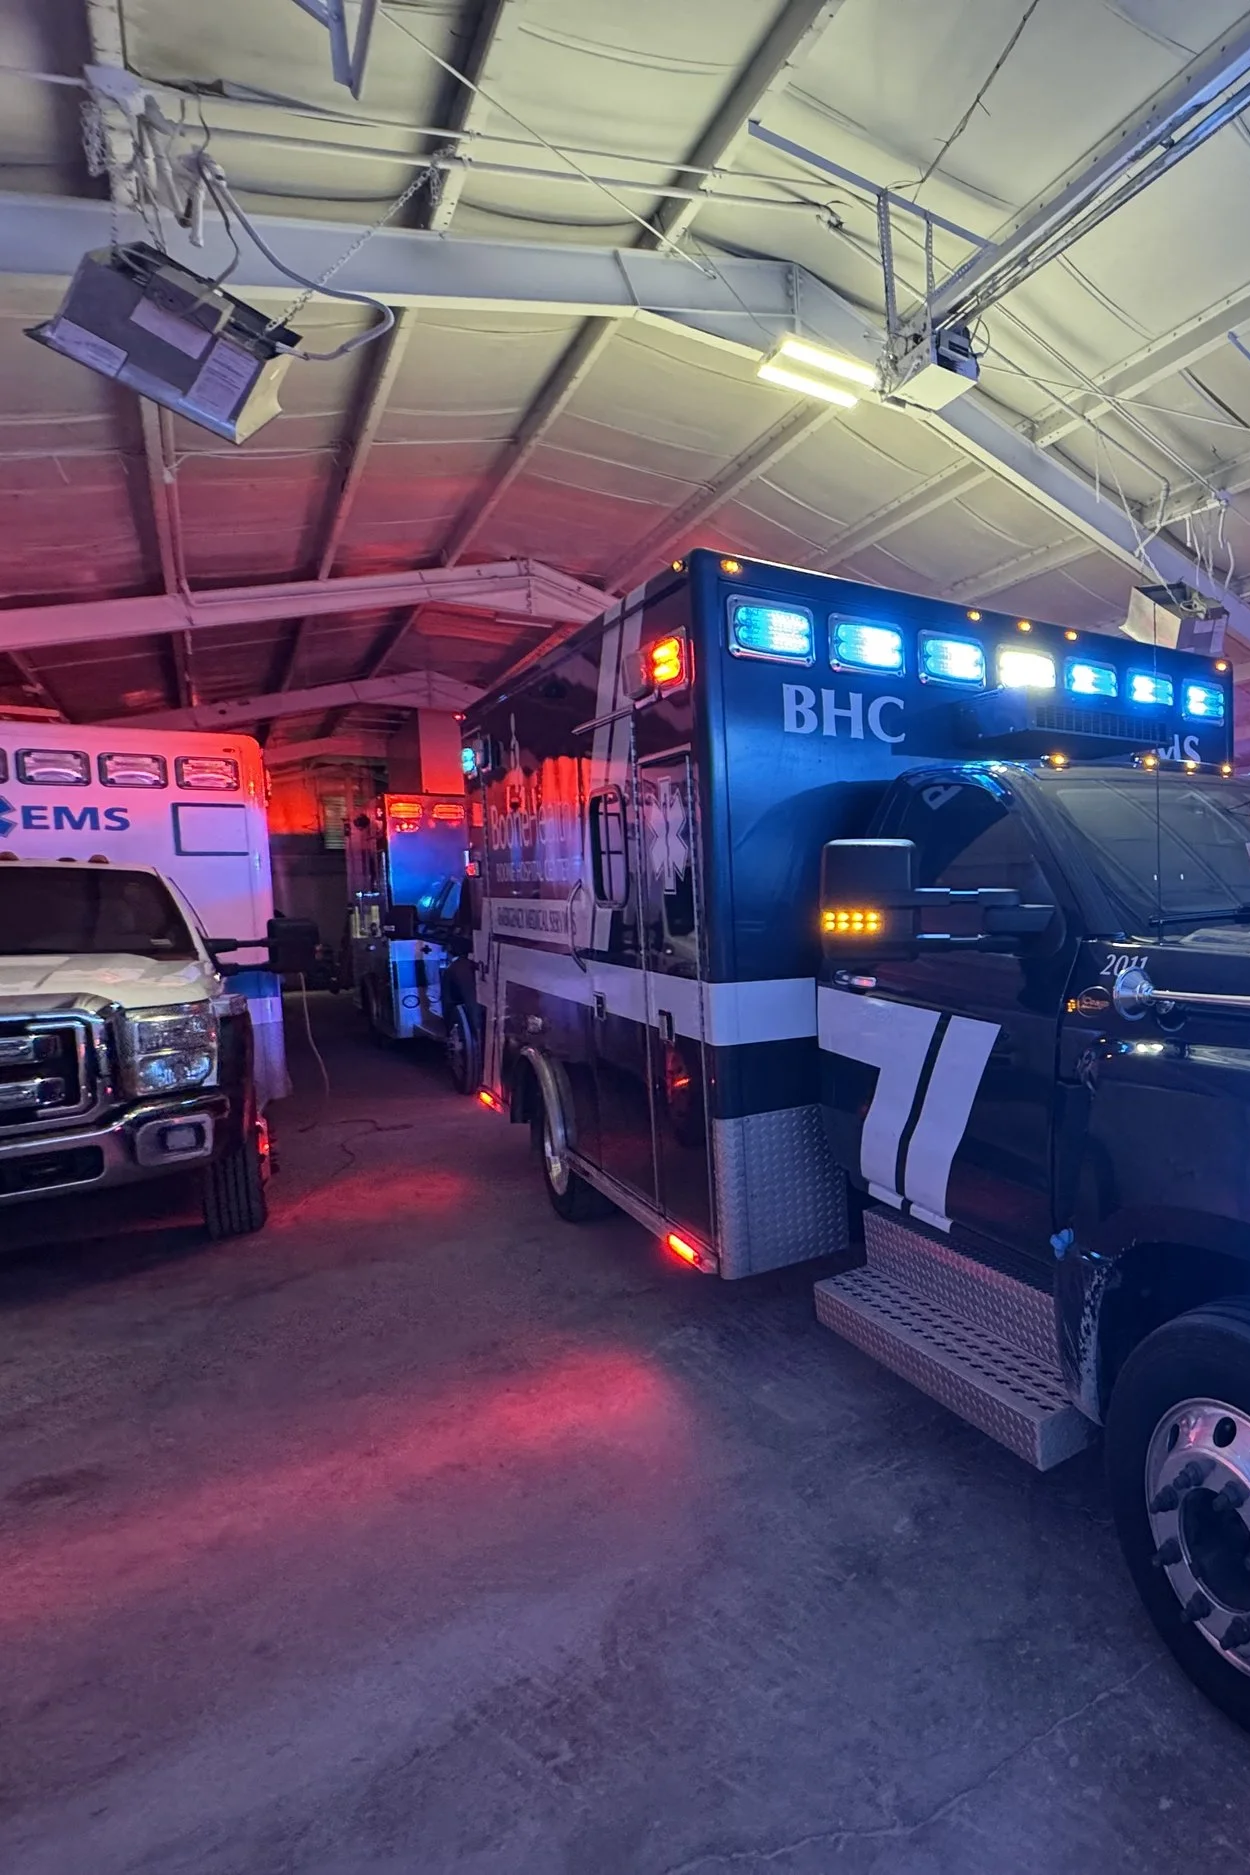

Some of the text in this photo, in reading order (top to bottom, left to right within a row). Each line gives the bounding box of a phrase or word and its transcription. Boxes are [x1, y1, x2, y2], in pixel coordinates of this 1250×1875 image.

[782, 683, 906, 743] BHC
[21, 805, 131, 831] EMS
[1100, 954, 1148, 975] 2011
